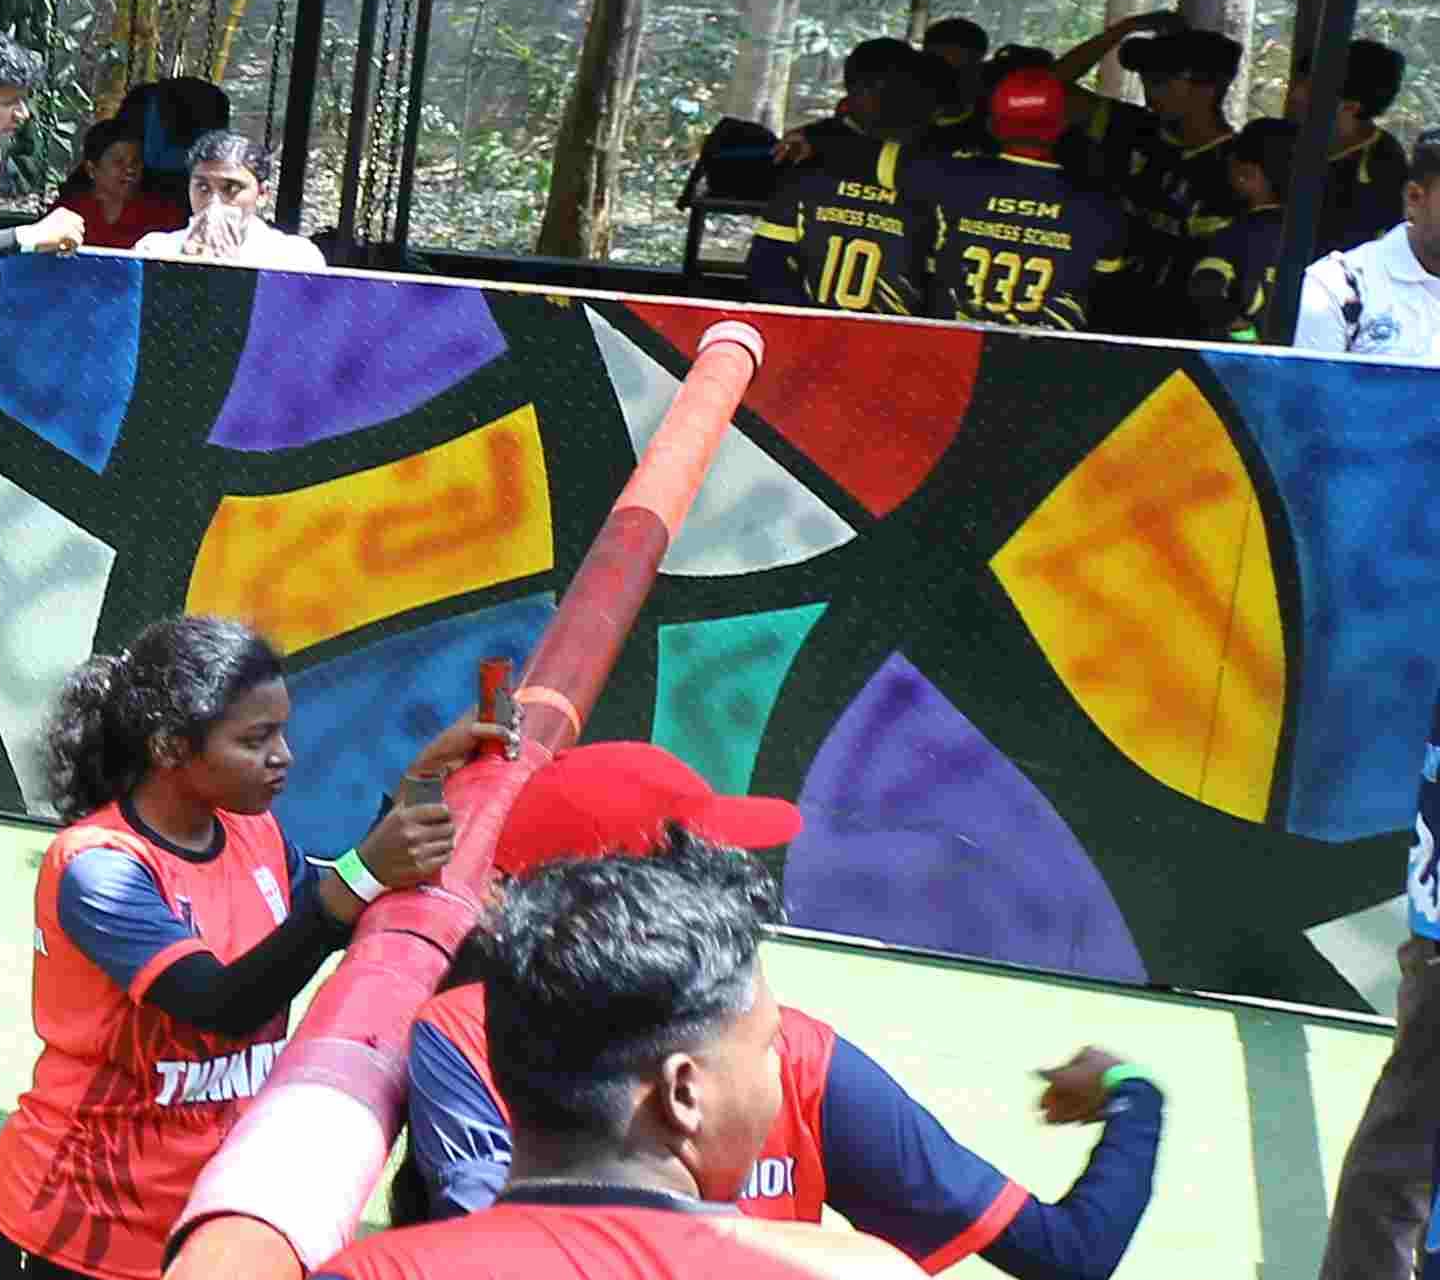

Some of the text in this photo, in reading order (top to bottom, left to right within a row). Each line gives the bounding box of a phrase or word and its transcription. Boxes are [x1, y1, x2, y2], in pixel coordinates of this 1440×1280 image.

[837, 180, 897, 205] ISSM
[987, 196, 1062, 219] ISSM
[1023, 227, 1073, 251] SCHOOL
[818, 234, 883, 310] 10
[963, 245, 1055, 312] 333
